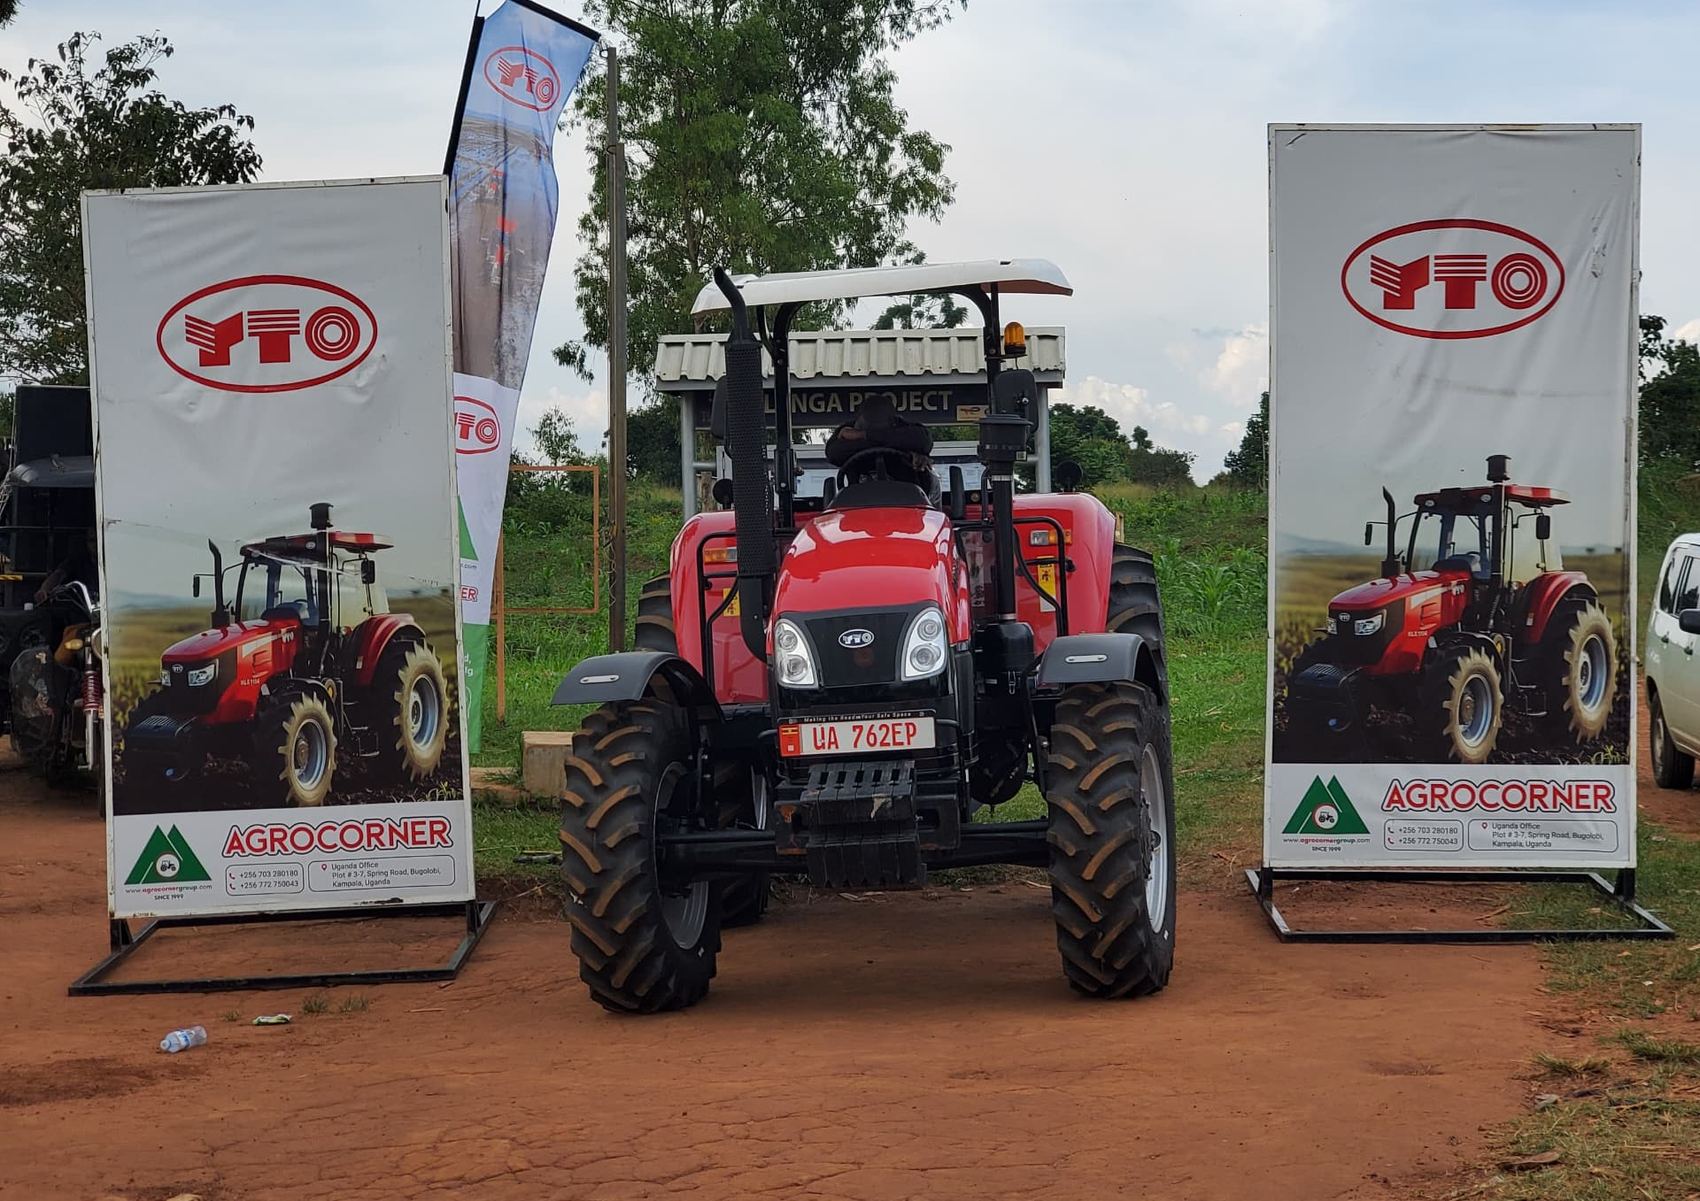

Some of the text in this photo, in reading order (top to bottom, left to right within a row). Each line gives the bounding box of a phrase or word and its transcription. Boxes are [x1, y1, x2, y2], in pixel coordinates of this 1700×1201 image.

[497, 55, 554, 104] YTO
[1370, 252, 1548, 310] YTO
[184, 306, 361, 367] YTO
[455, 411, 498, 445] TO
[813, 721, 918, 751] UA 762EP
[1385, 783, 1613, 811] AGROCORNER
[1398, 826, 1459, 835] +256 703 280180
[1491, 822, 1541, 831] Uganda Office
[225, 819, 450, 856] AGROCORNER
[1398, 837, 1459, 845] +256 772 750043
[1492, 831, 1506, 839] Plot
[1527, 831, 1551, 841] Spring
[1551, 831, 1571, 840] Road,
[1492, 840, 1552, 849] Kampala, Uganda
[331, 861, 379, 871] Uganda Office
[239, 869, 299, 879] +256 703 280180
[332, 871, 346, 879] Plot
[366, 869, 389, 878] Spring
[389, 868, 410, 877] Road,
[240, 879, 299, 890] +256 772 750043
[332, 878, 391, 889] Kampala, Uganda
